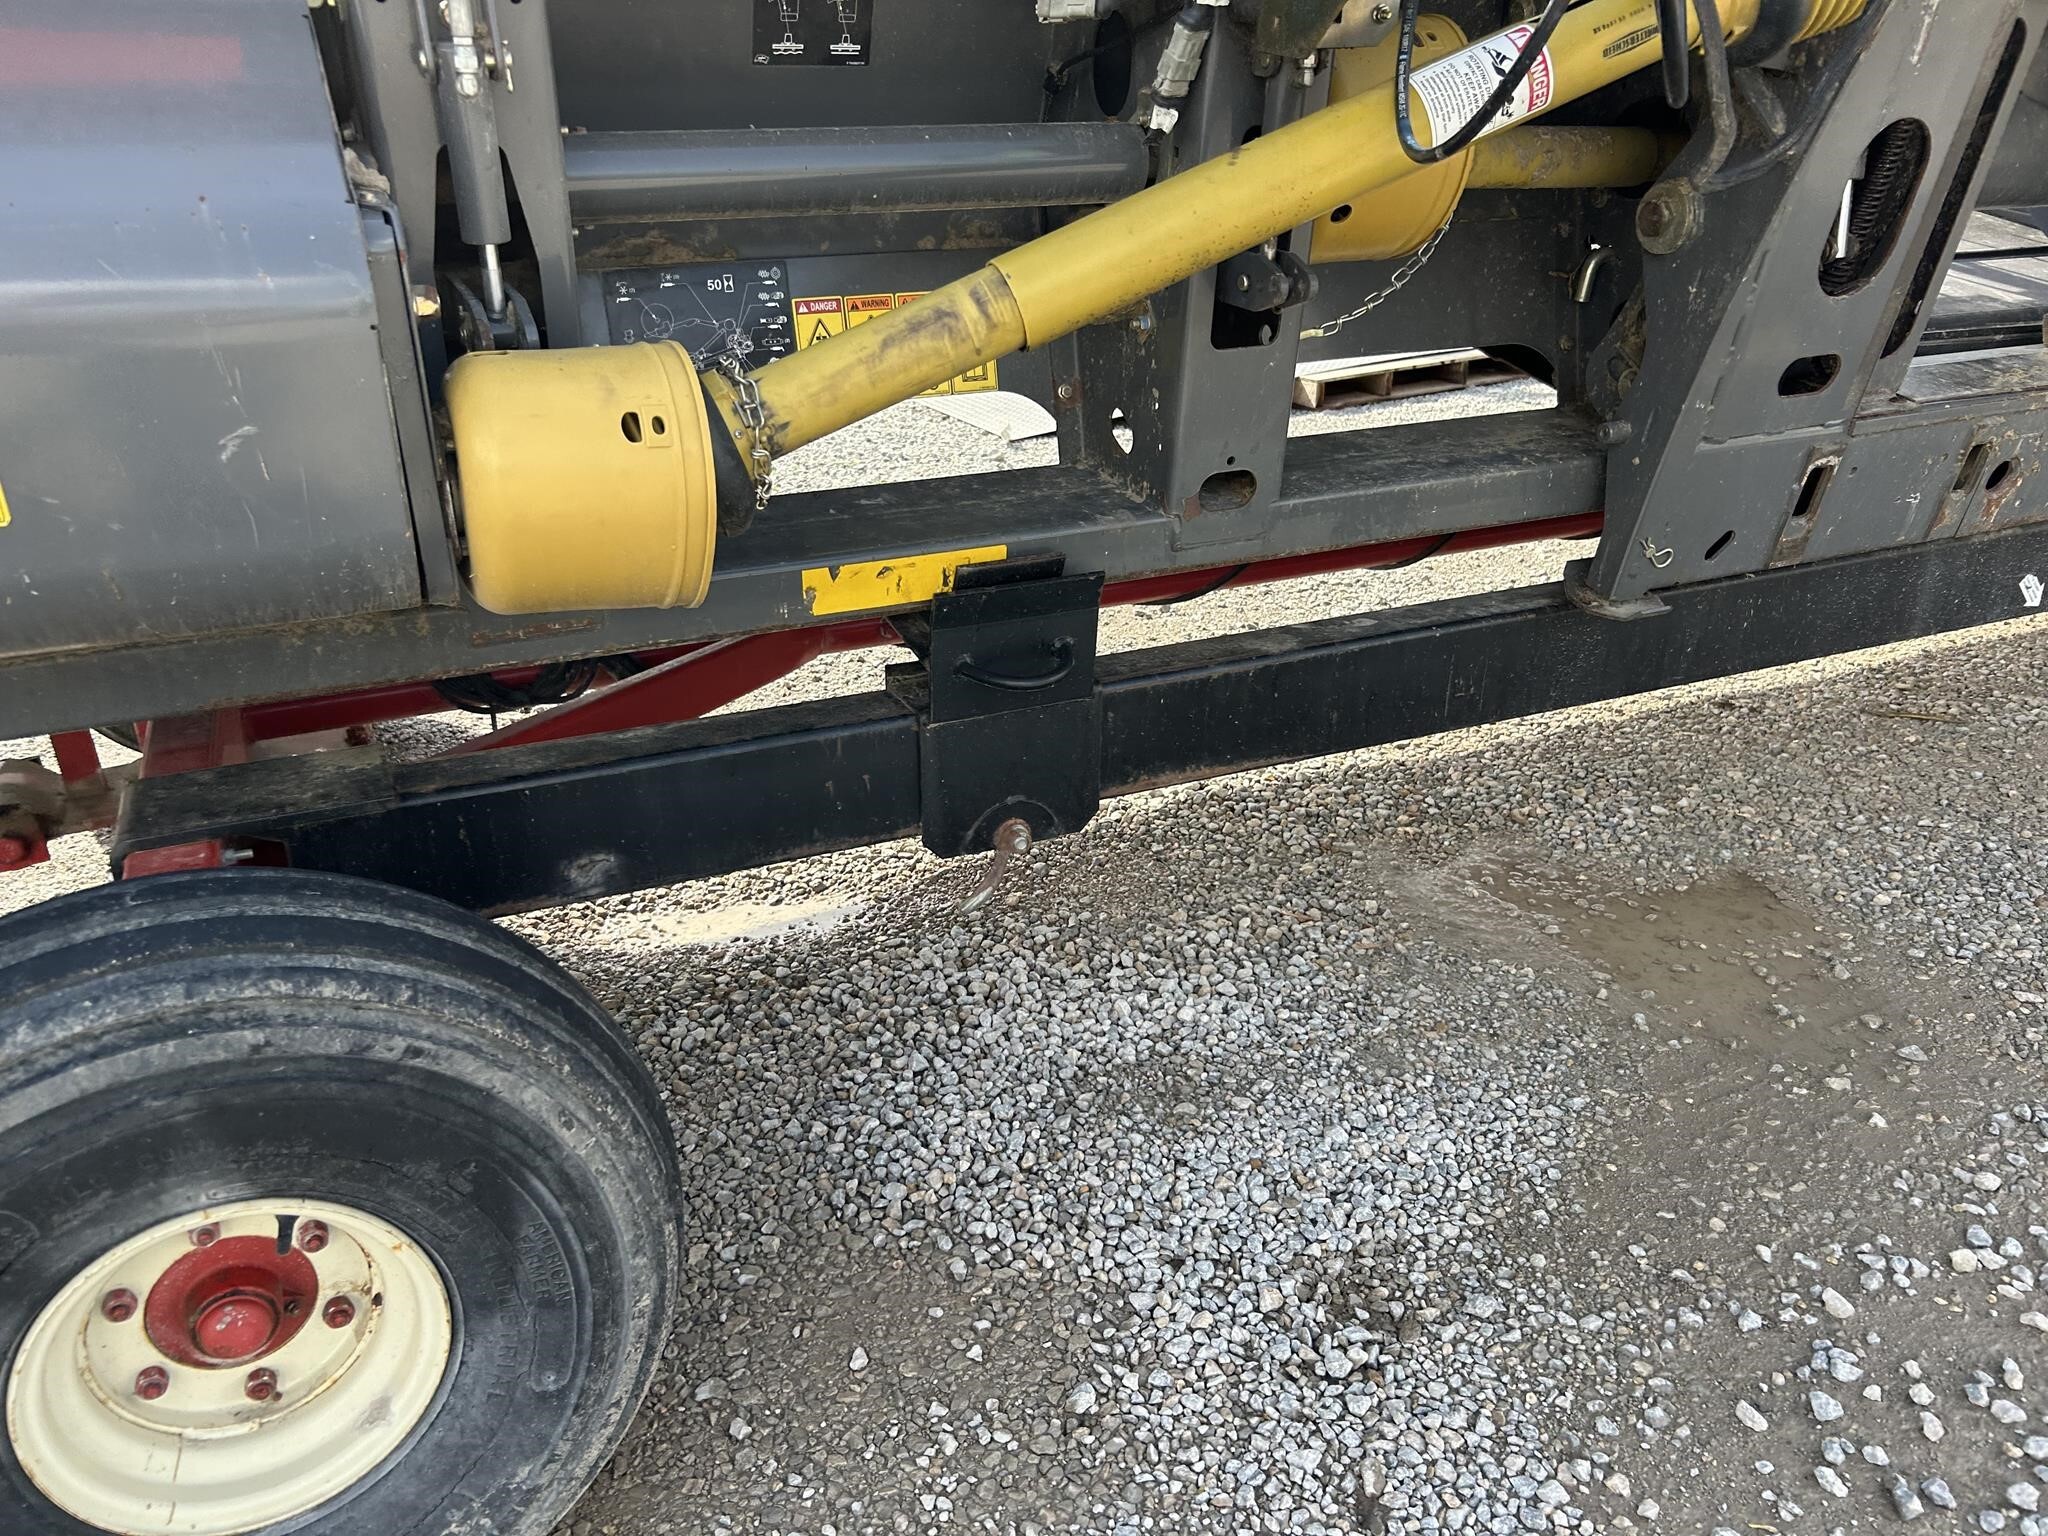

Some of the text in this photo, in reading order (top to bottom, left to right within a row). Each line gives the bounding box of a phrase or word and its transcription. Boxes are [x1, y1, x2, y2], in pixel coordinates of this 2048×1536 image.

[1447, 62, 1455, 70] DO
[1453, 68, 1463, 78] NOT
[1459, 79, 1472, 106] OPERATE
[1463, 59, 1478, 79] CONTACT
[1466, 53, 1489, 86] ROTATING
[1529, 57, 1550, 112] ANGER
[1462, 71, 1480, 110] KEEP AWA
[707, 279, 722, 291] 50
[810, 301, 838, 312] DANGER
[860, 298, 890, 309] WARNING
[514, 1234, 552, 1300] FARMER
[528, 1221, 572, 1305] AMERICAN
